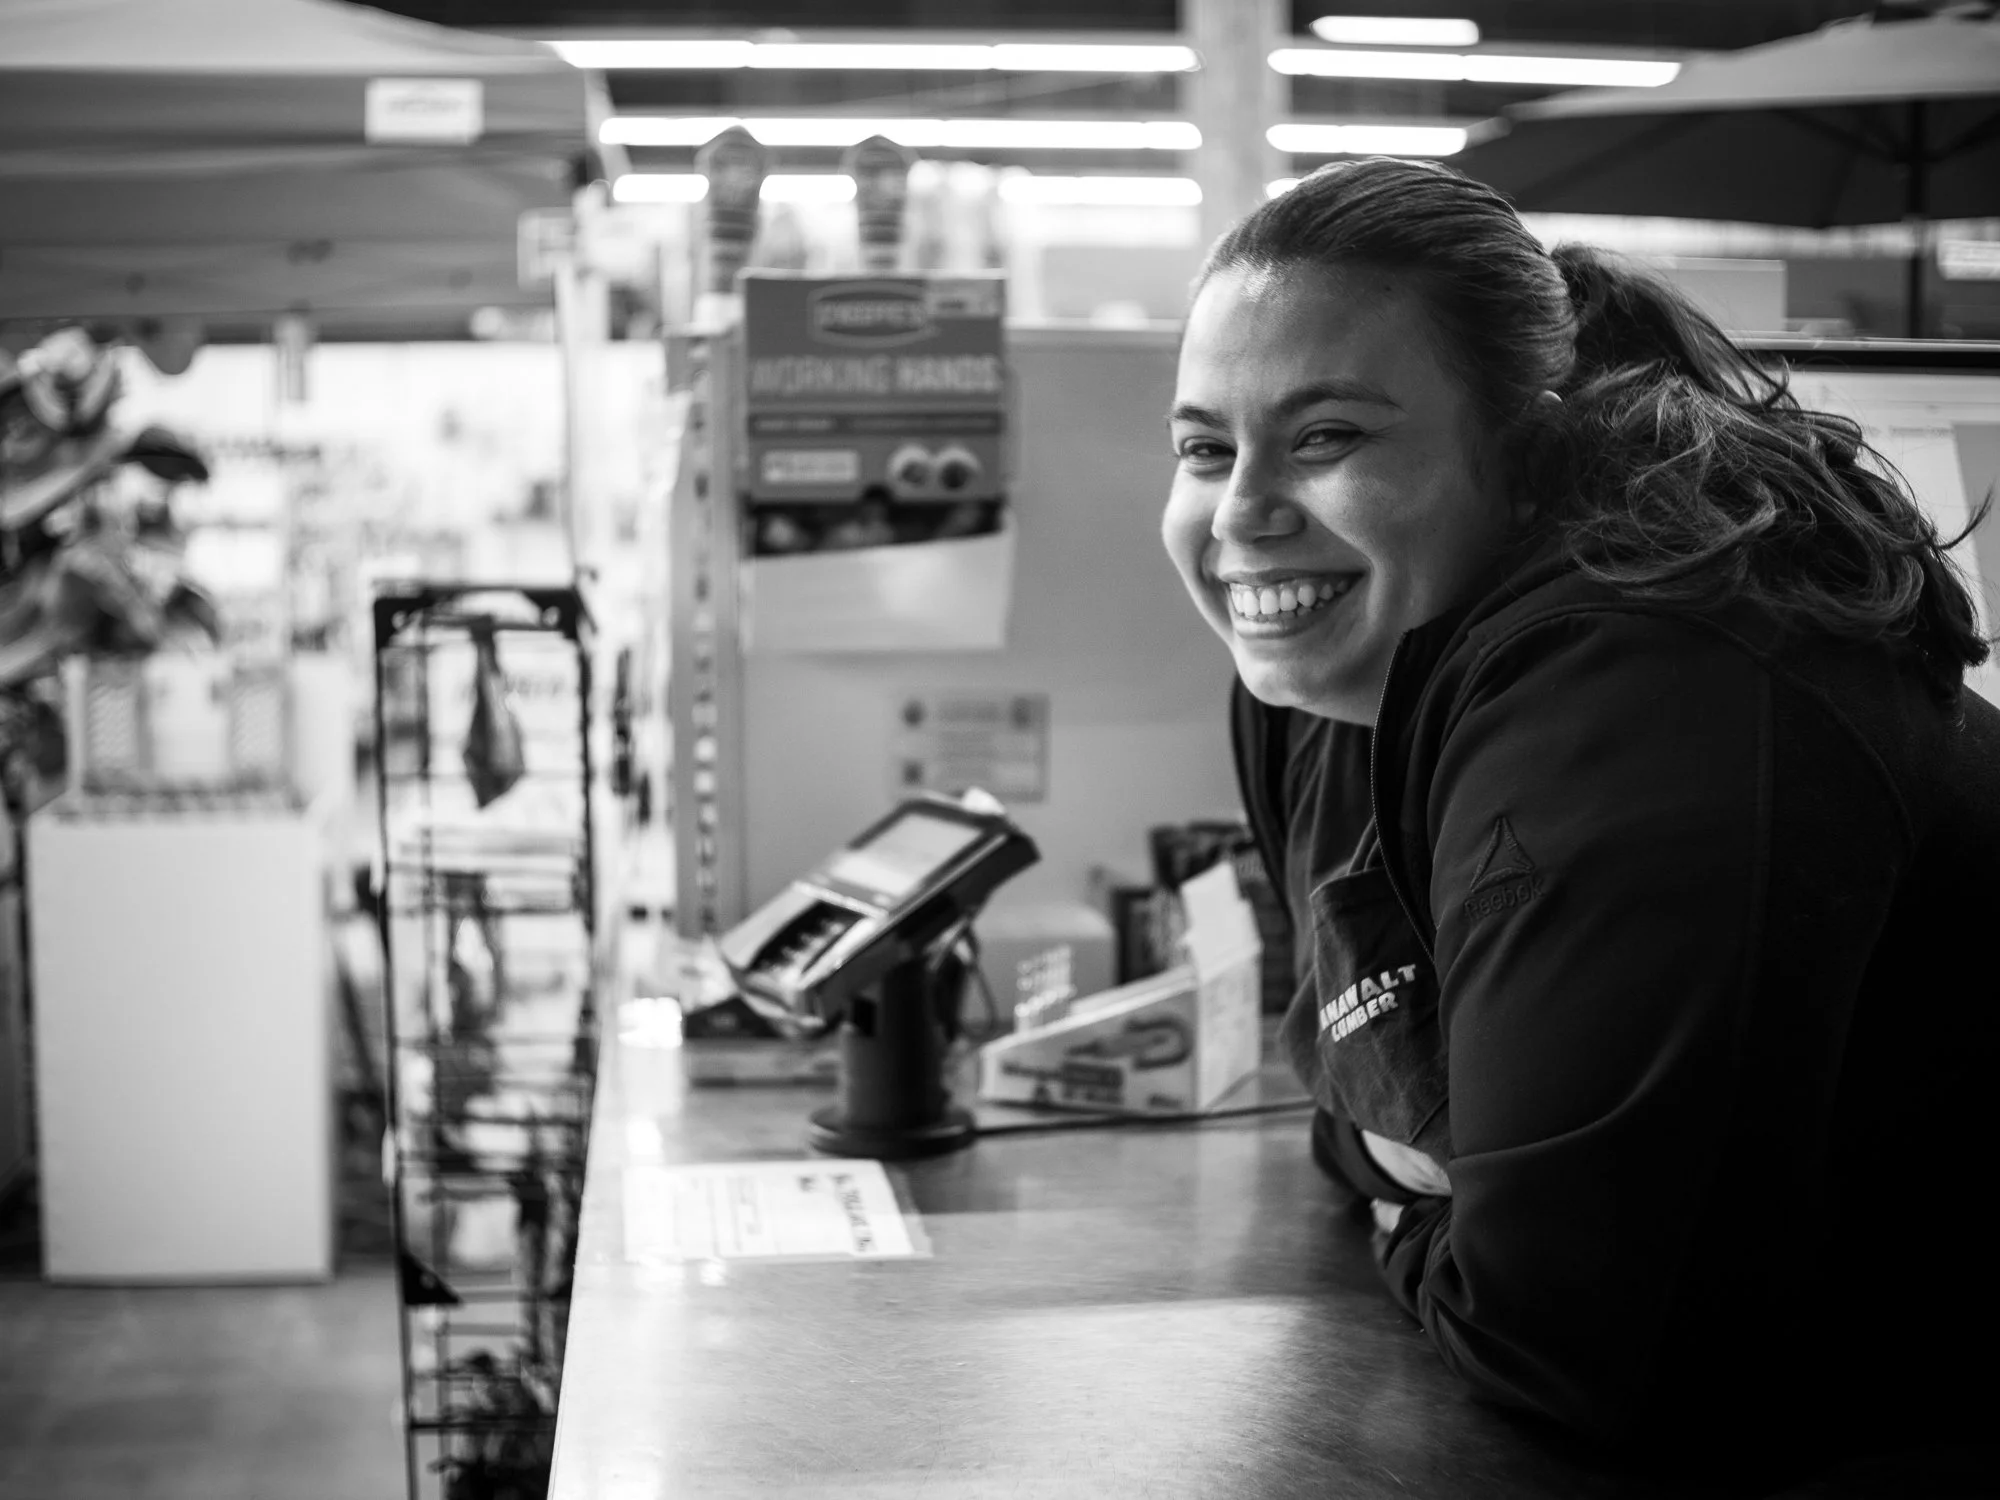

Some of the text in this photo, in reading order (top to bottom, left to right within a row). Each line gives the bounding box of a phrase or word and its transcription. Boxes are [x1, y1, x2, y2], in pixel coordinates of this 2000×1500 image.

[752, 355, 998, 393] WORKING HANDS
[1464, 878, 1544, 921] Reebok
[1331, 992, 1398, 1042] LUMBER
